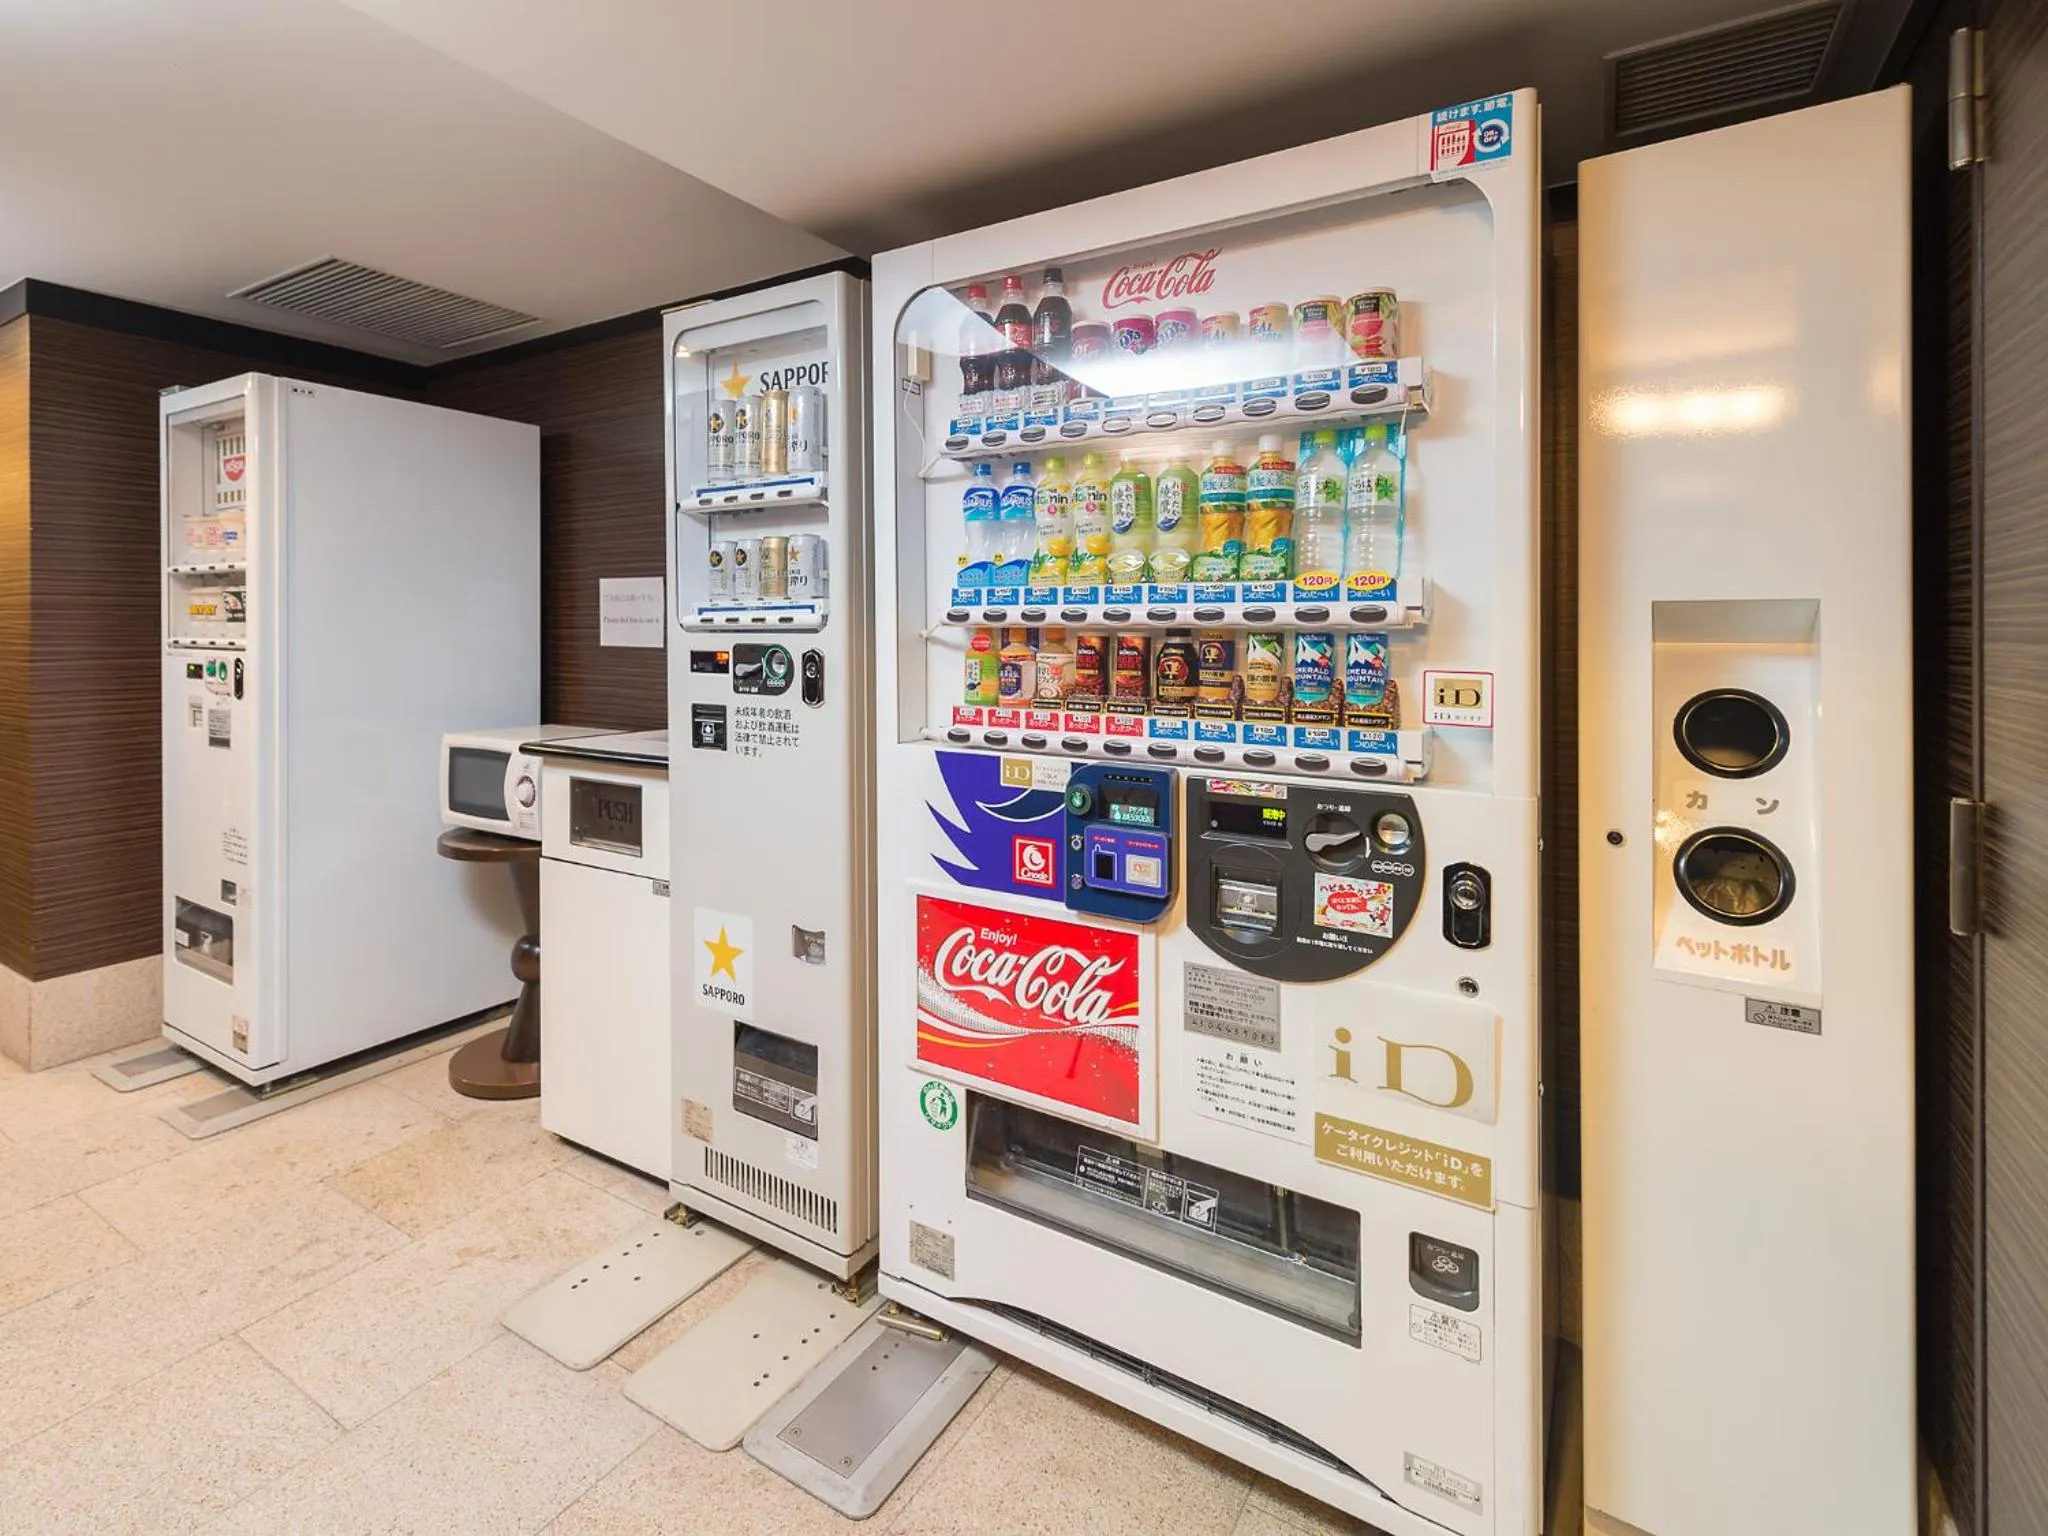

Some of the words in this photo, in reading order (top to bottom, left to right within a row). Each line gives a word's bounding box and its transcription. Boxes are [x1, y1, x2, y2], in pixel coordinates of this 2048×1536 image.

[1103, 247, 1223, 309] Coca-Cola
[1302, 576, 1333, 586] 120円
[1354, 575, 1386, 586] 120円
[735, 706, 791, 720] 未成年者の飲酒
[735, 719, 799, 734] および飲酒運転は
[735, 731, 799, 748] 法律で禁止されて
[1005, 764, 1031, 780] iD
[597, 797, 635, 824] PUSH
[980, 928, 1018, 946] Enjoy!
[1676, 936, 1792, 971] ペットボトル
[934, 927, 1127, 1027] Coca-Cola
[702, 983, 745, 1006] SAPPORO
[1325, 1027, 1474, 1109] iD
[1336, 1143, 1466, 1191] ご利用いただけます。
